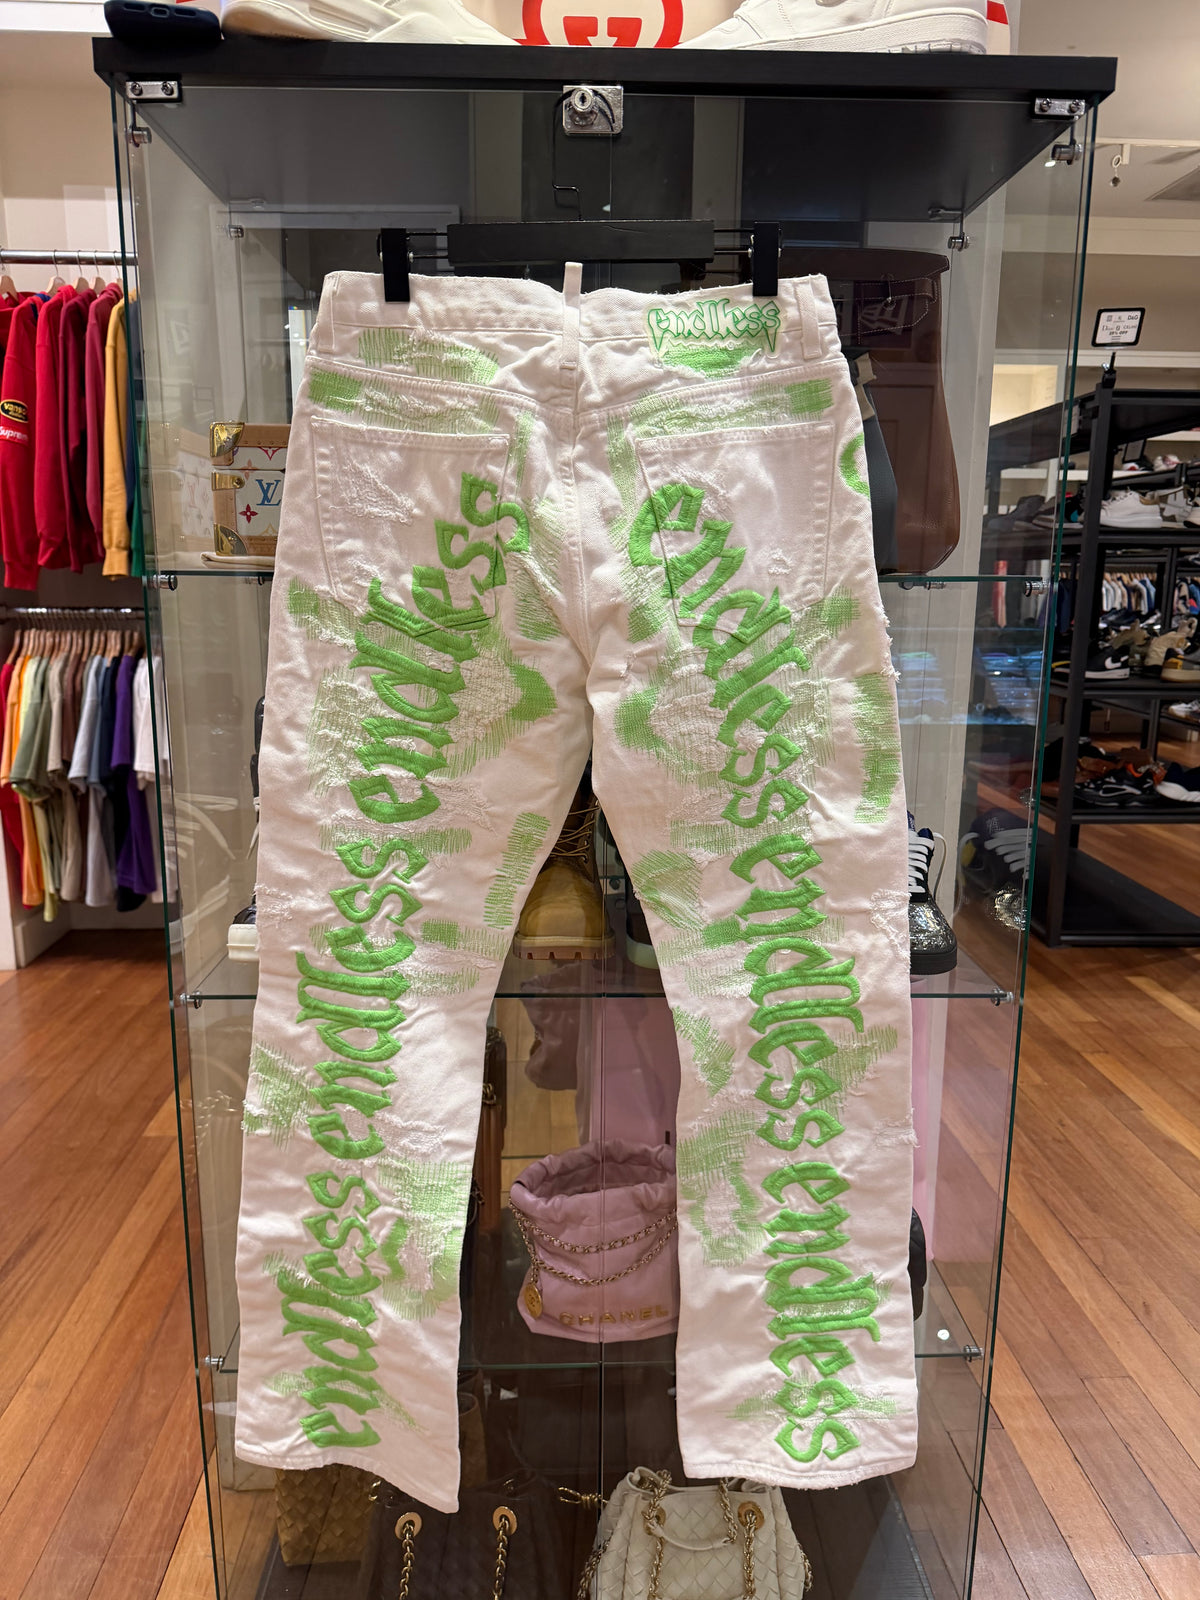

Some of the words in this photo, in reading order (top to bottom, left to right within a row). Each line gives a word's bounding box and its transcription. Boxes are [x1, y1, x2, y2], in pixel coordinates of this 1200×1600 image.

[348, 472, 530, 824] endless
[628, 483, 811, 828] endless
[296, 838, 429, 1160] endless
[729, 833, 864, 1151] endless
[279, 1172, 381, 1448] endless
[559, 1305, 669, 1326] CHANEL
[760, 1161, 882, 1464] endless
